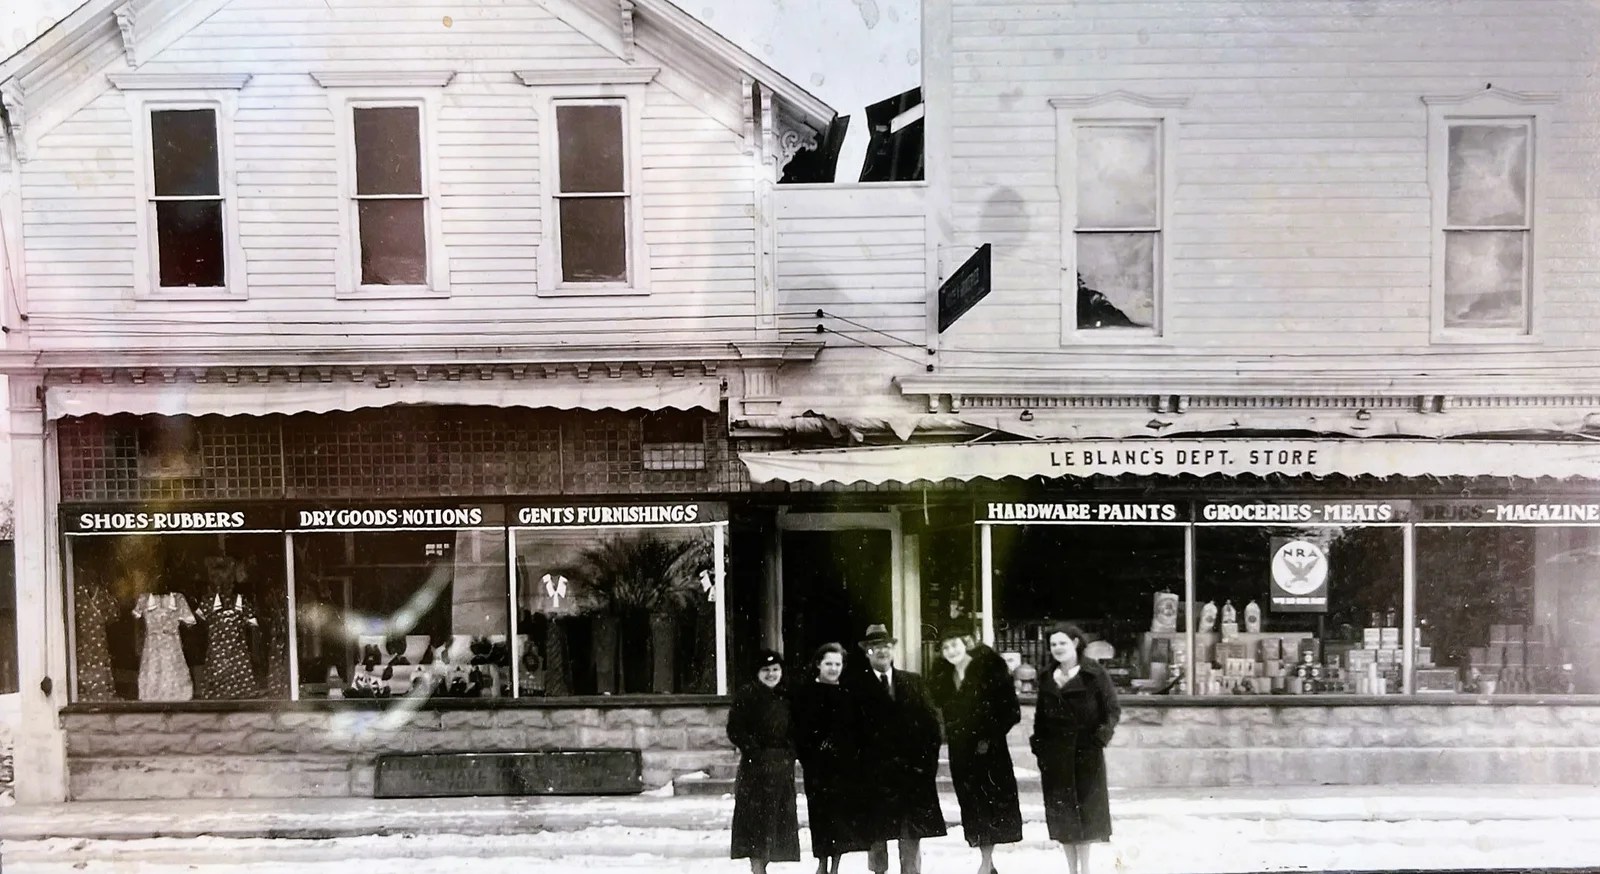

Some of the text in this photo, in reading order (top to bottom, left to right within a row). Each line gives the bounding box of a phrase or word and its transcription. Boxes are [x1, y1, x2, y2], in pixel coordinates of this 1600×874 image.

[1176, 450, 1234, 465] DEPT.
[1249, 449, 1318, 465] STORE
[577, 504, 698, 523] FURNISHINGS
[1283, 548, 1318, 558] NRA
